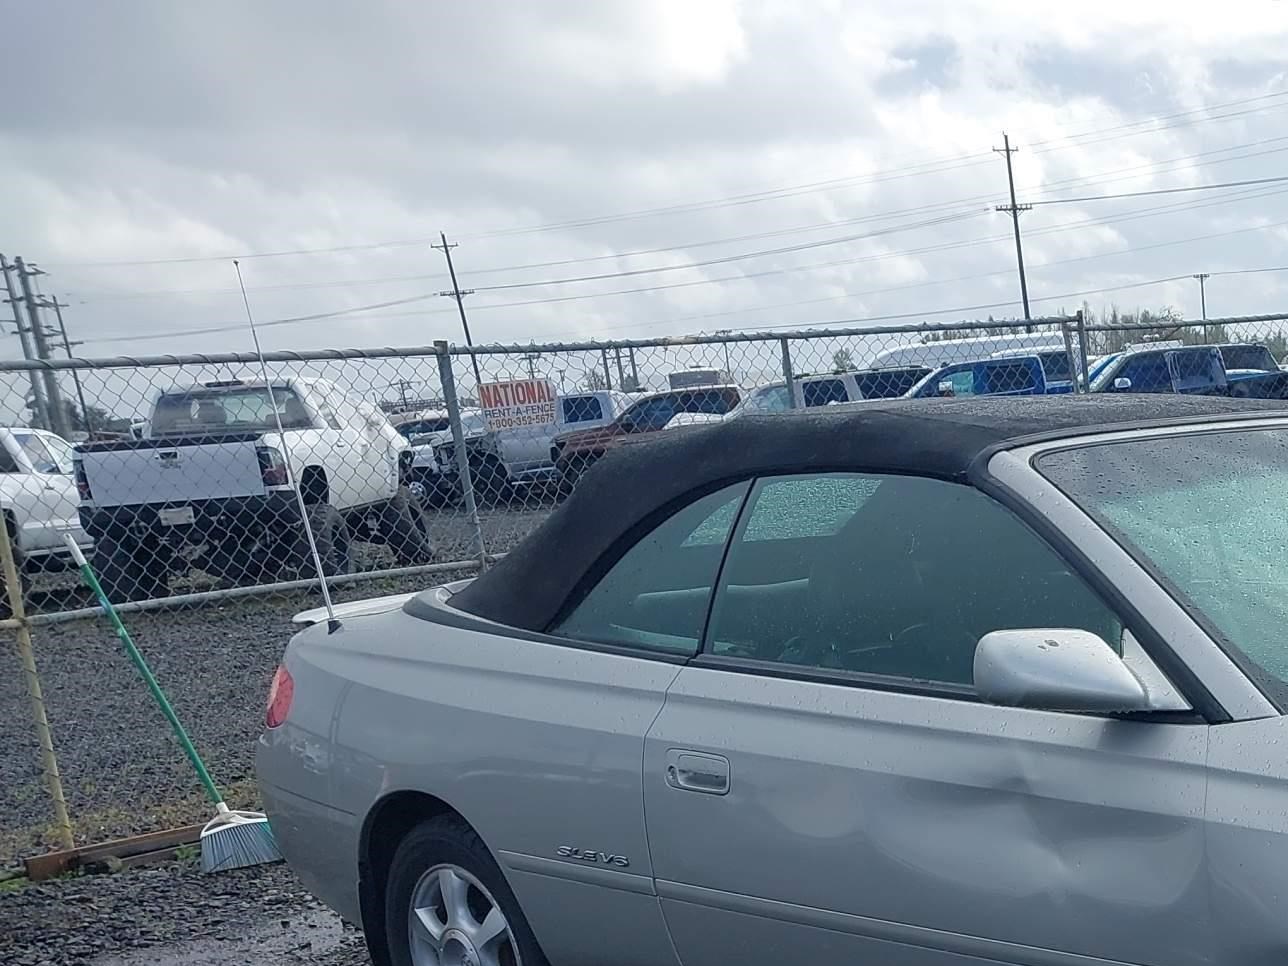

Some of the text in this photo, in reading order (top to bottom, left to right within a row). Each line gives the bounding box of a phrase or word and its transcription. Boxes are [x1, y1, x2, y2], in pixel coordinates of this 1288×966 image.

[480, 380, 555, 408] NATIONAL
[484, 402, 556, 418] RENT-A-FENCE
[556, 845, 629, 867] SLE V6
